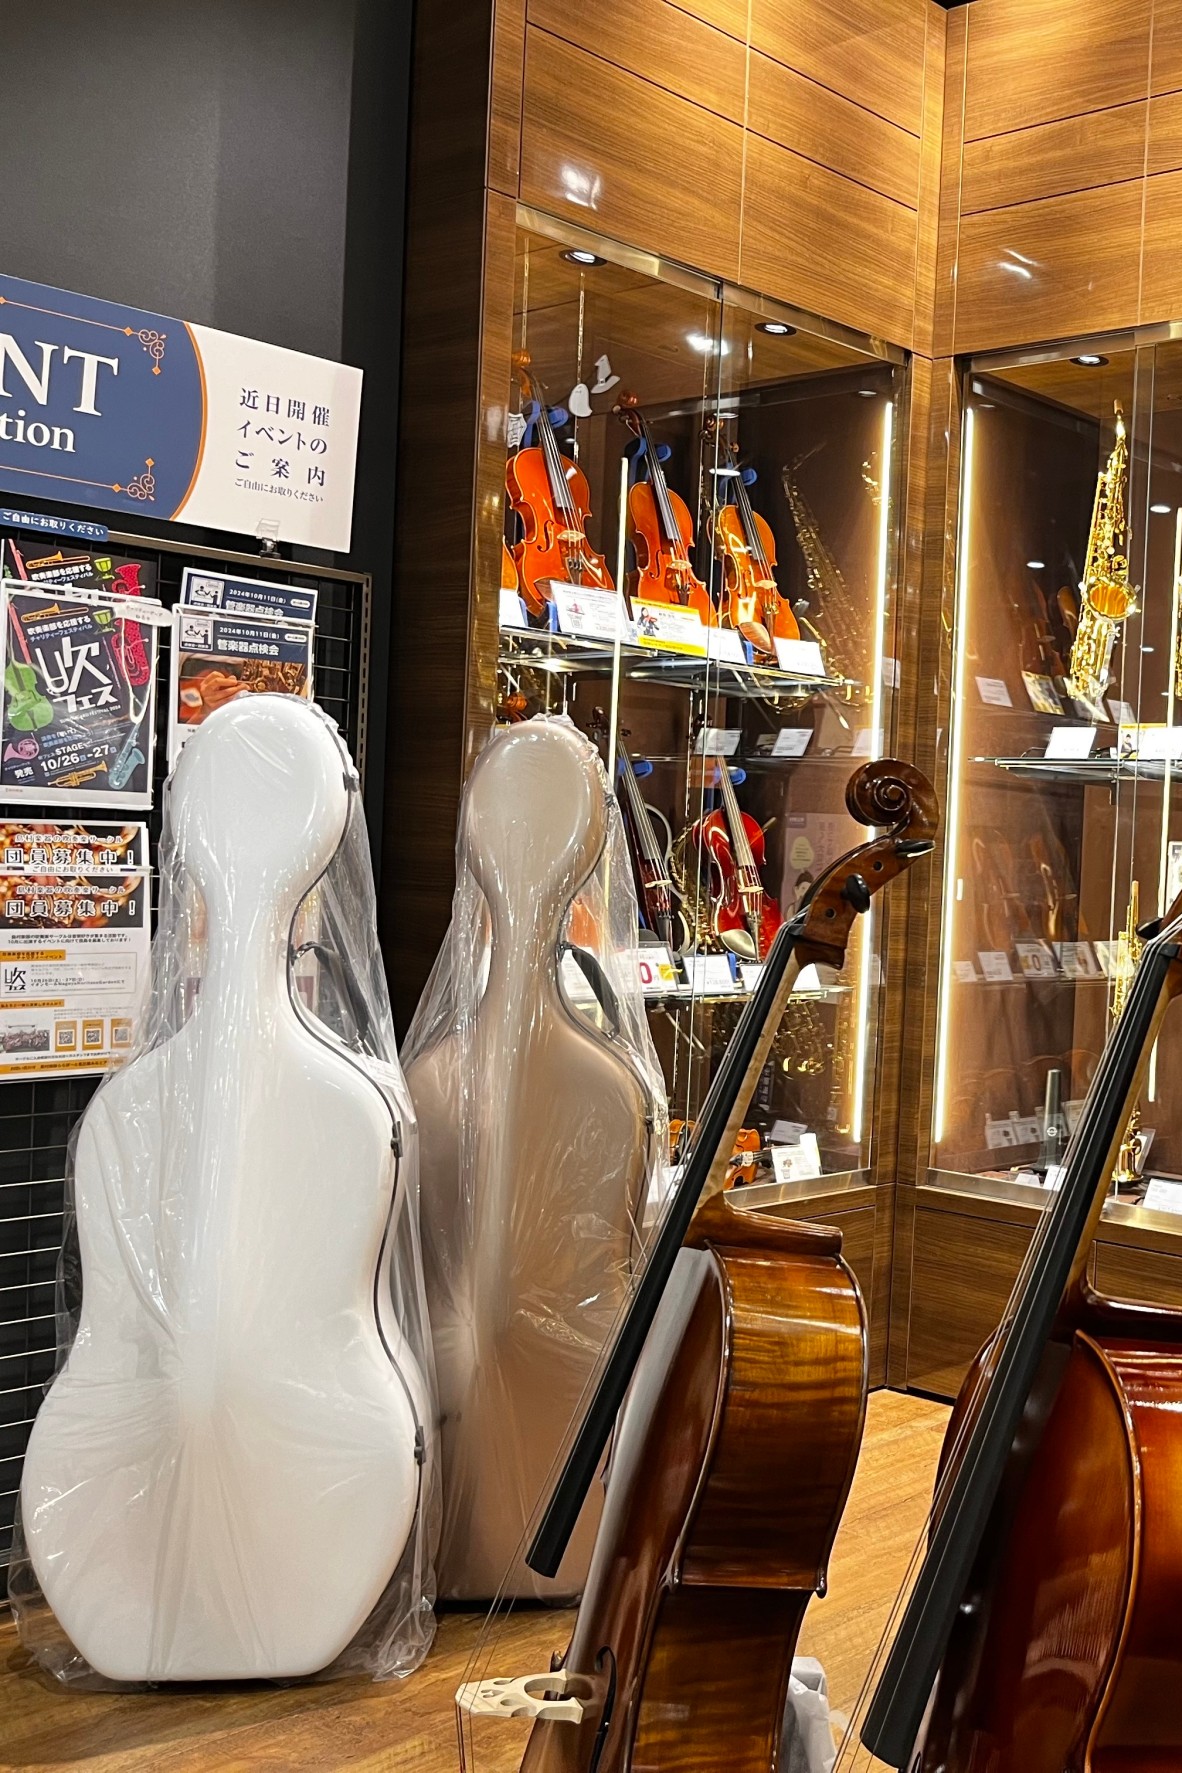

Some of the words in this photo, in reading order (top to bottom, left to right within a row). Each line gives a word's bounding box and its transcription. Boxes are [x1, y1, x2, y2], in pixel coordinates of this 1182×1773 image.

[239, 387, 331, 428] 近日開催
[236, 419, 328, 456] イベントの
[234, 450, 327, 487] ご案内
[233, 478, 324, 504] ご自由にお取りください
[2, 512, 104, 536] ご自由にお取りください
[219, 626, 280, 640] 2024年10月11日(金)
[217, 638, 280, 656] 管楽器点検会
[55, 742, 84, 757] STAGE
[41, 752, 80, 772] 10/26
[6, 899, 136, 918] 団員募集中！
